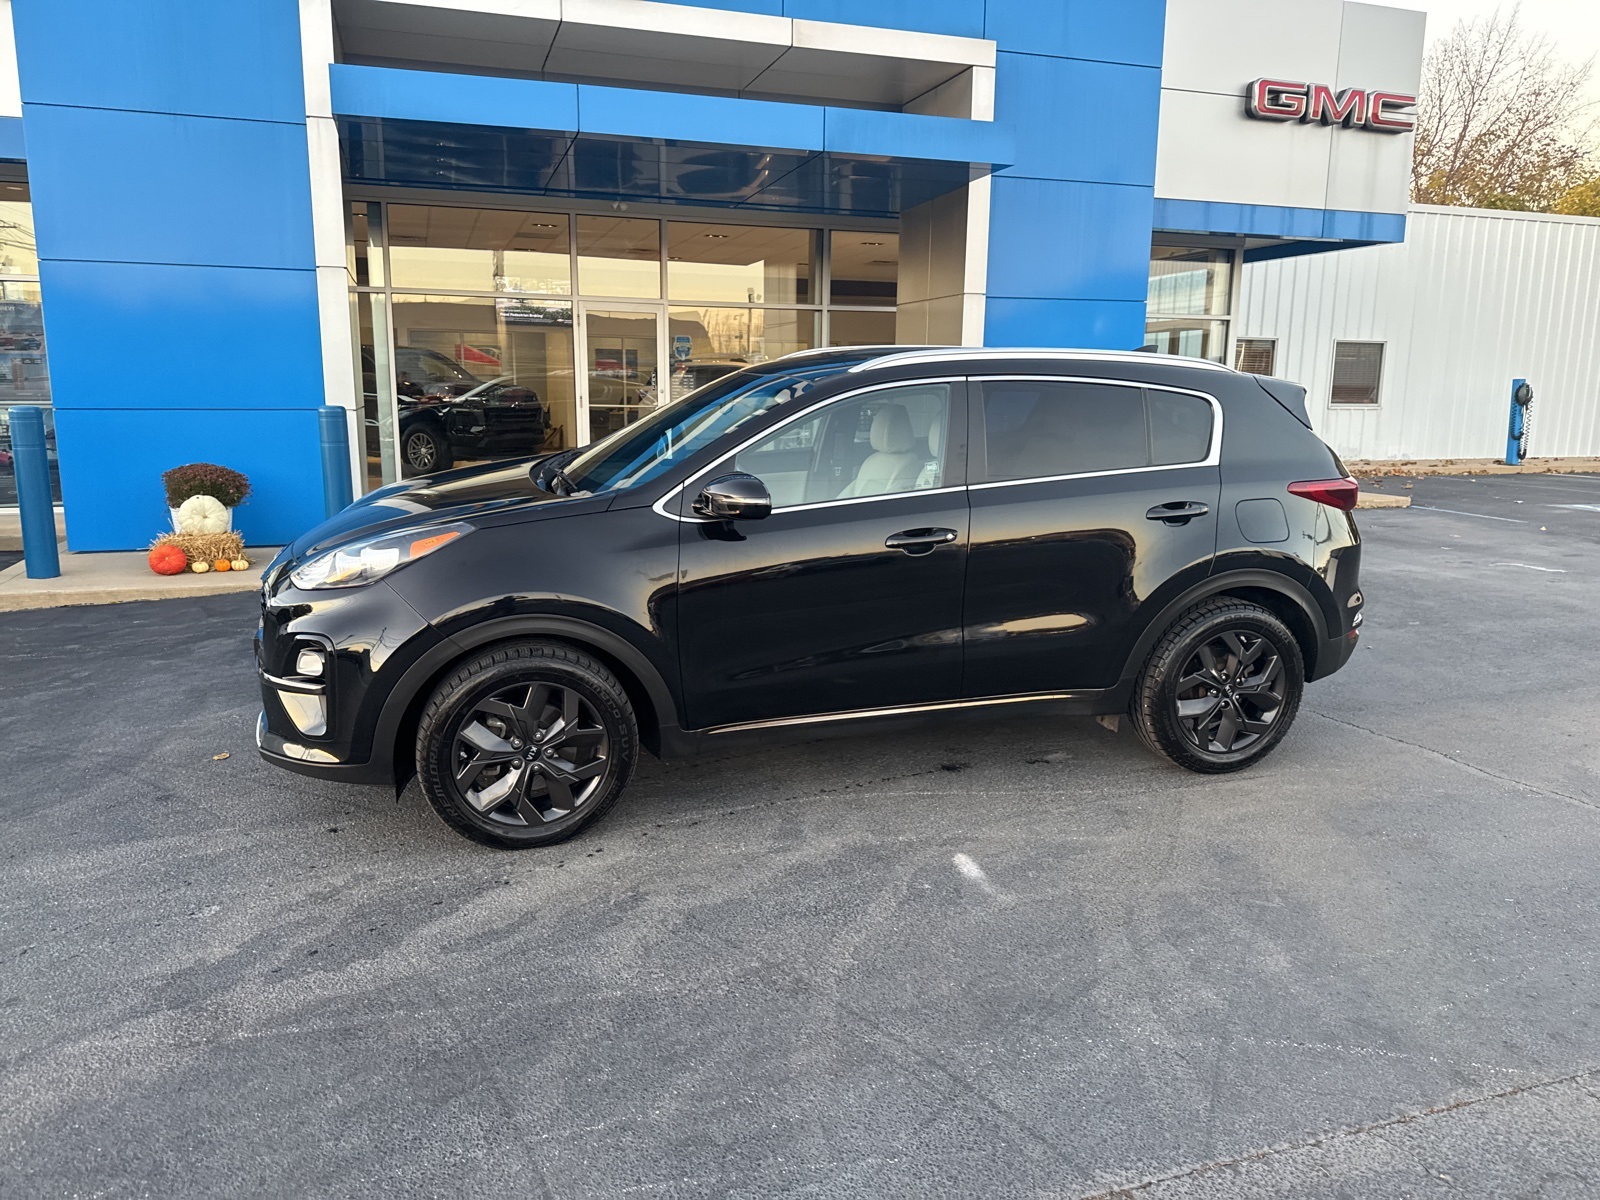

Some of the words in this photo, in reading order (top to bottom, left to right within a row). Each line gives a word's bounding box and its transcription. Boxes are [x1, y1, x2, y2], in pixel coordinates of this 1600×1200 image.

[1246, 77, 1416, 132] GMC
[1224, 685, 1233, 698] KIA
[526, 746, 538, 760] KIA
